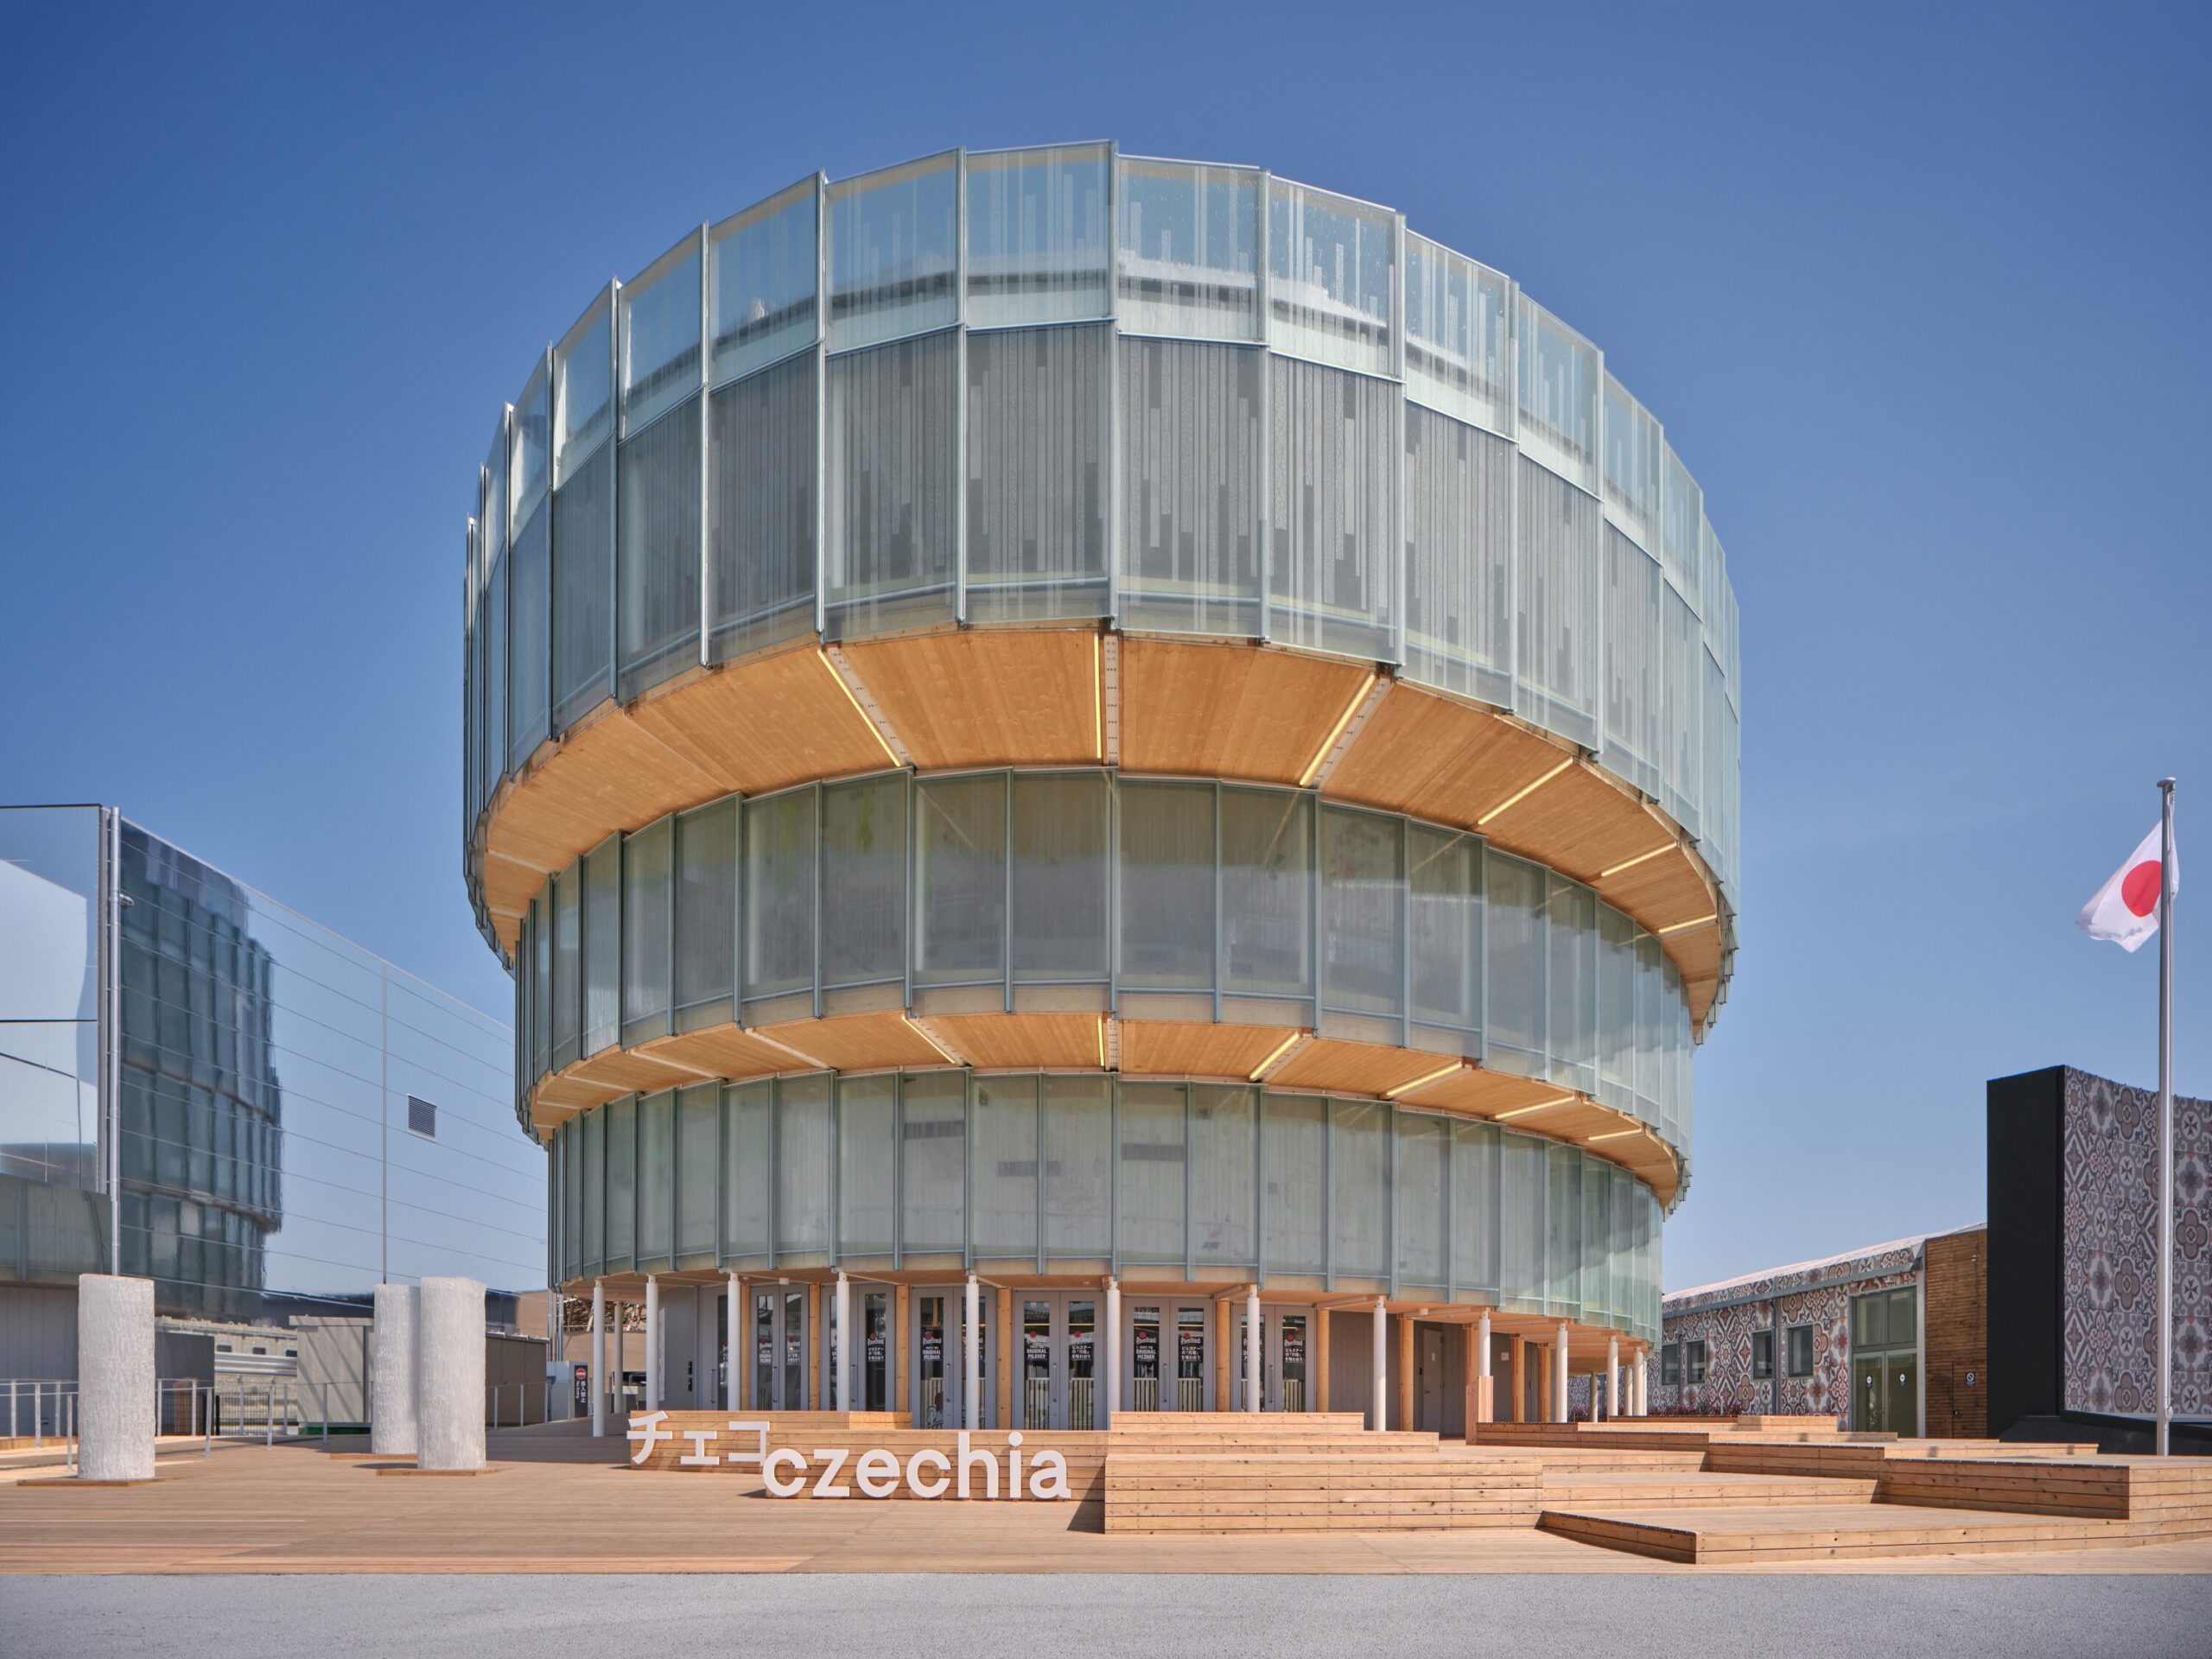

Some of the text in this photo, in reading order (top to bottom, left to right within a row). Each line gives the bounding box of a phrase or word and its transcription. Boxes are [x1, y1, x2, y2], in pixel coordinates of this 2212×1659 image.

[626, 1411, 770, 1466] チェコ
[762, 1431, 1072, 1499] czechia
